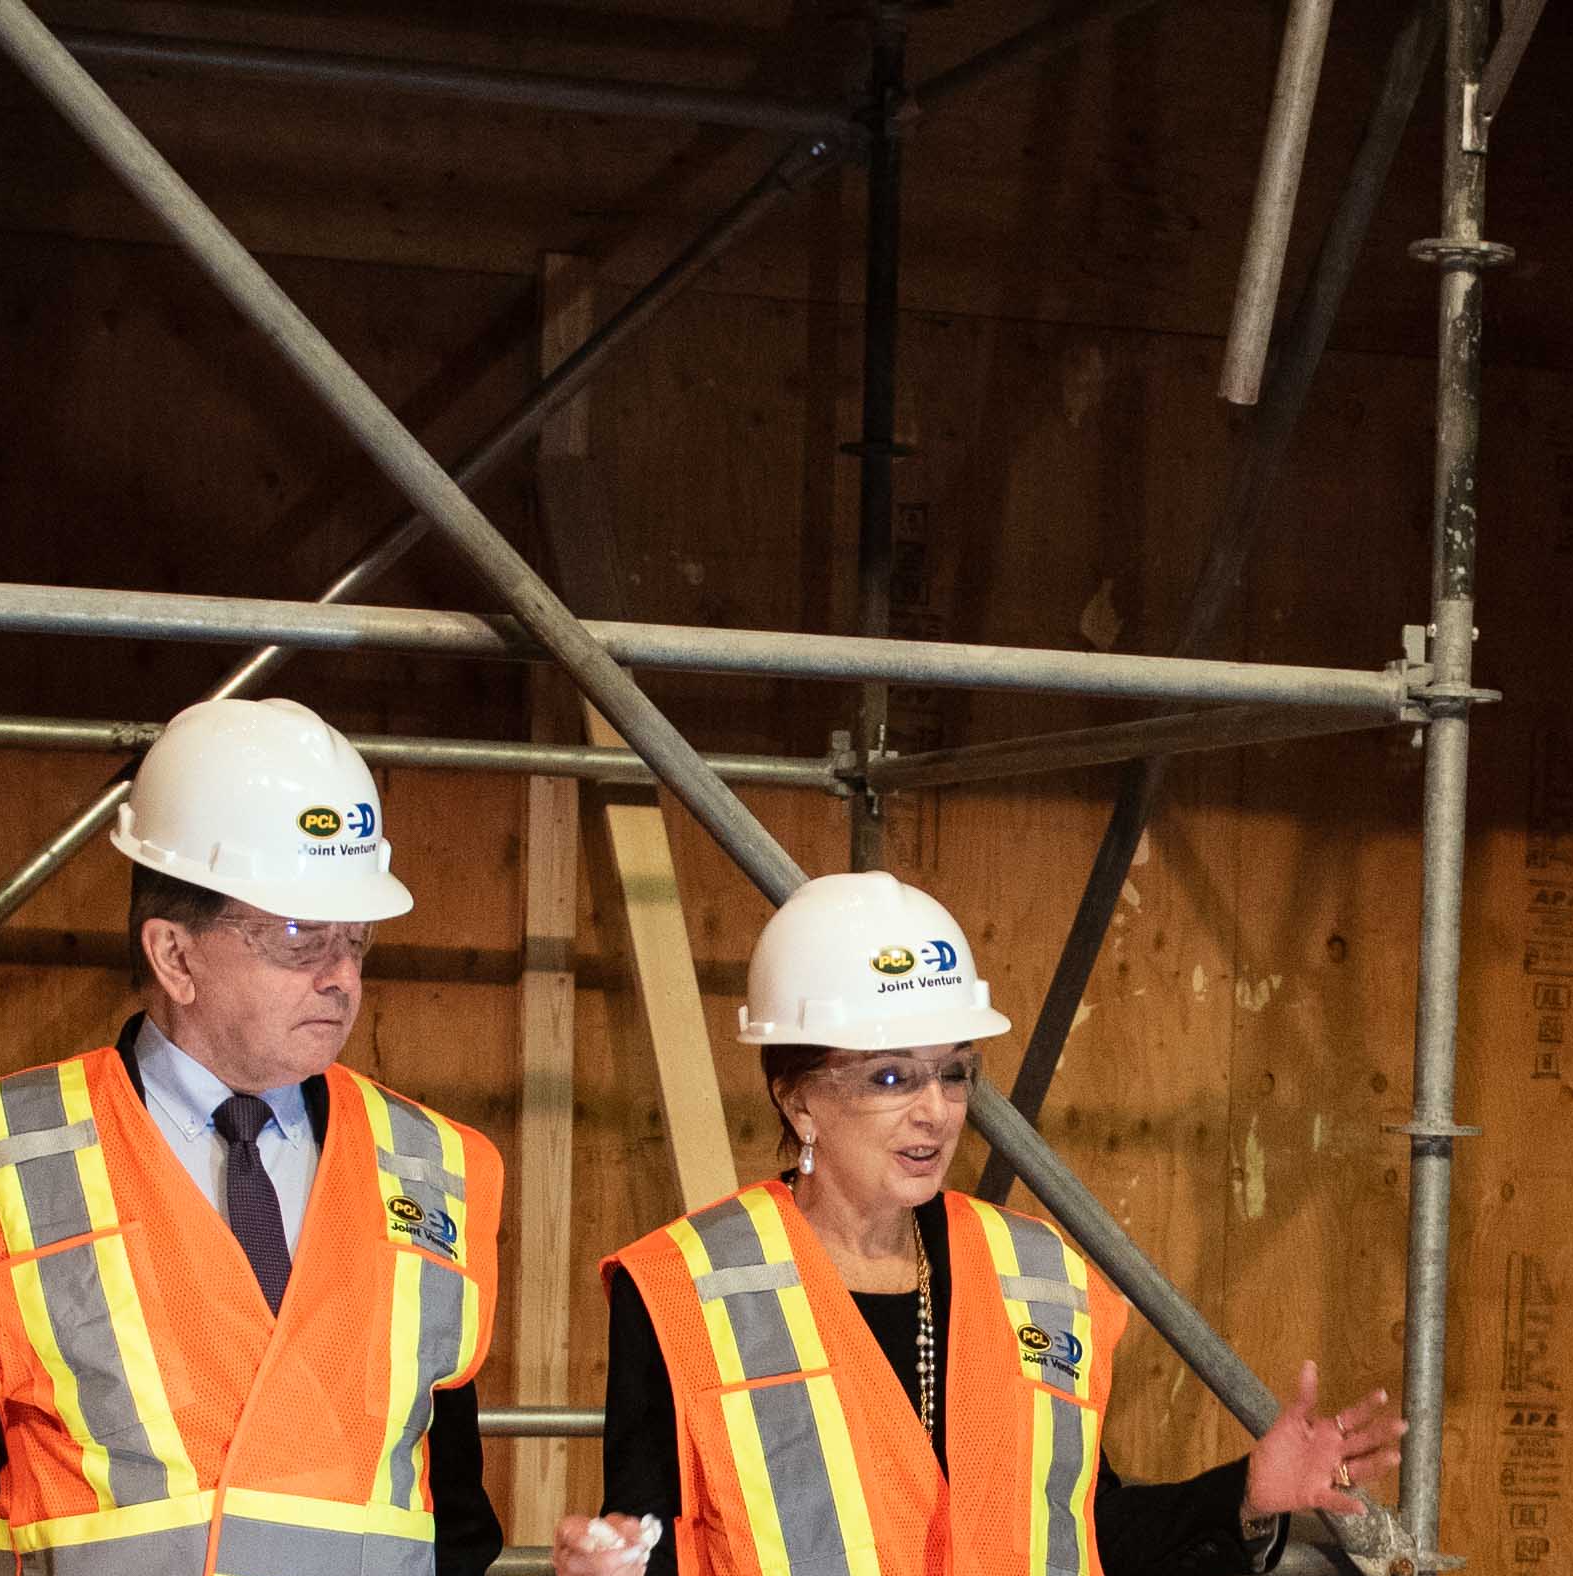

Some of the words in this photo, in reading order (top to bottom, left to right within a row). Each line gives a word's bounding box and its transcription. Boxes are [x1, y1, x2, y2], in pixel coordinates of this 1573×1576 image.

[305, 814, 338, 829] PCL
[339, 842, 377, 857] Venture
[877, 980, 915, 994] Joint
[917, 975, 963, 989] Venture
[393, 1200, 422, 1220] PCL
[391, 1221, 422, 1238] Joint
[1022, 1330, 1048, 1346] PCL
[1021, 1352, 1049, 1368] Joint
[1510, 1410, 1558, 1427] APA
